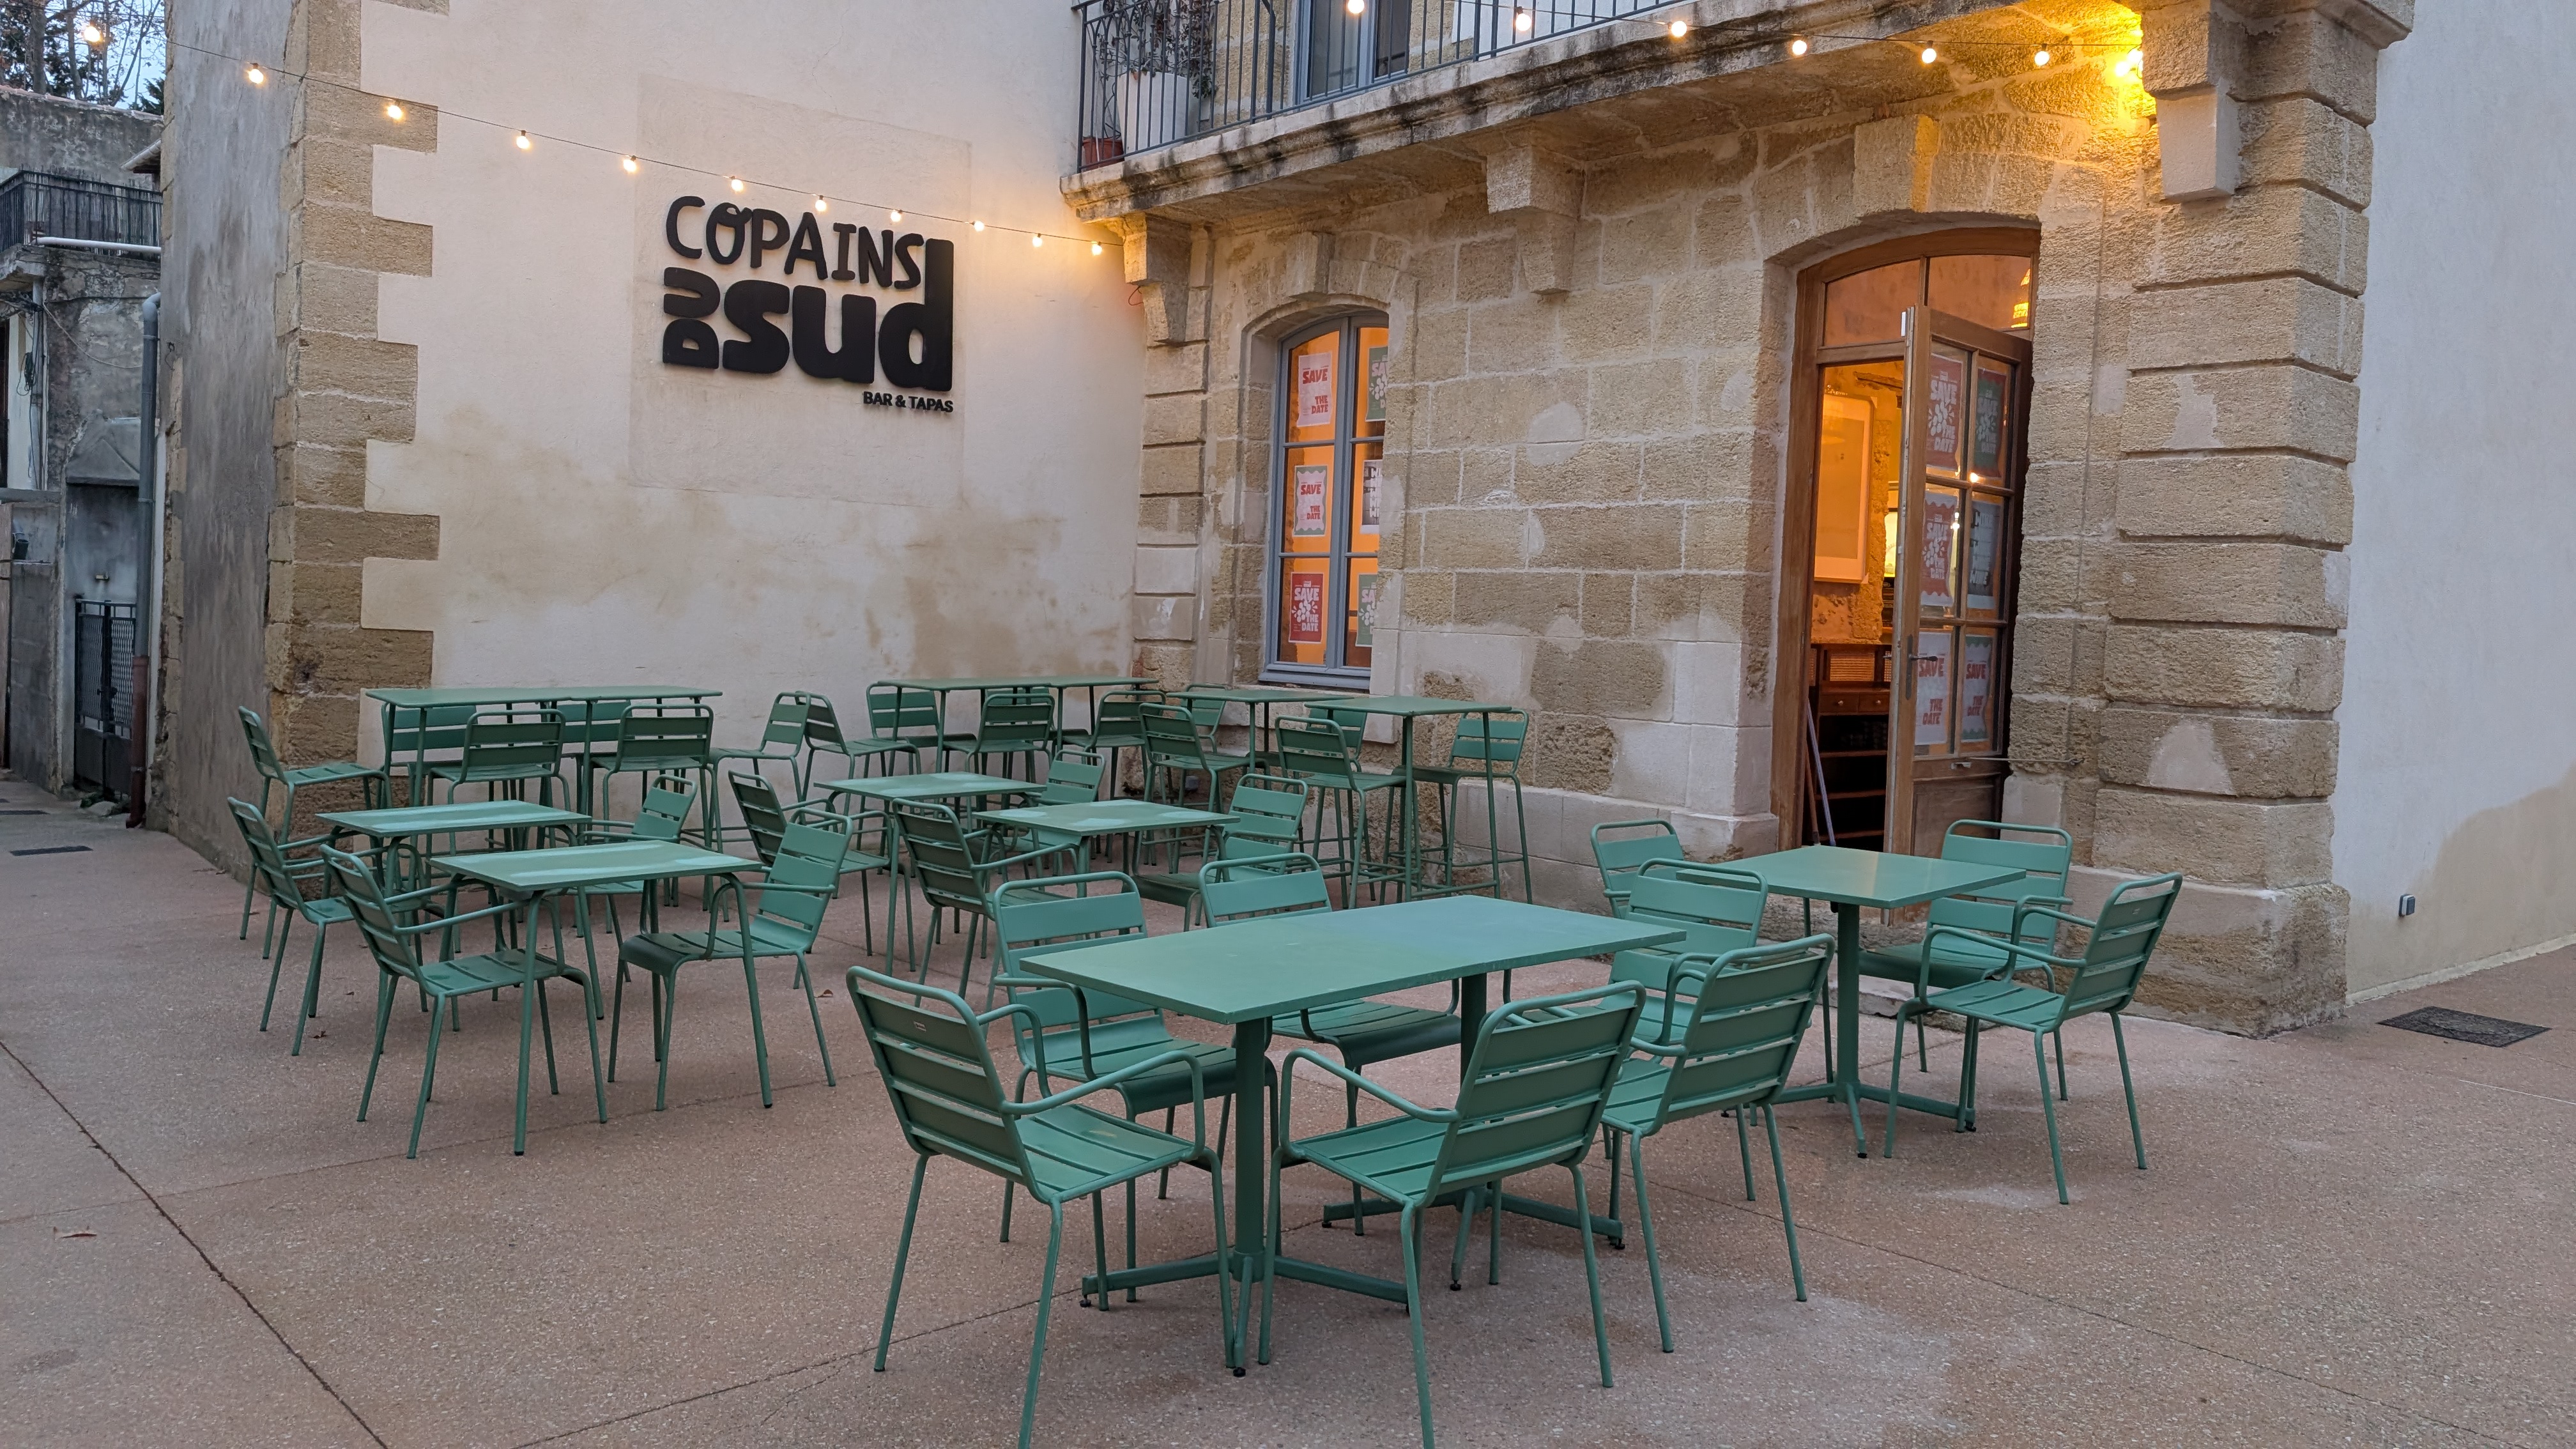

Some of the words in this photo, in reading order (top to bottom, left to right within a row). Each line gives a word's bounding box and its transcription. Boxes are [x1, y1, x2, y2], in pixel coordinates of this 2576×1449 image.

[666, 196, 924, 289] COPAINS
[1303, 369, 1328, 384] SAVE
[1315, 395, 1328, 404] THE
[1930, 380, 1958, 406] SAVE
[863, 391, 893, 406] BAR
[895, 395, 907, 408] &
[908, 396, 953, 413] TAPAS
[1312, 404, 1329, 414] DATE
[1934, 437, 1954, 452] DATE
[1300, 484, 1322, 495] SAVE
[1927, 523, 1948, 541] SAVE
[1294, 588, 1319, 601] SAVE
[1361, 589, 1376, 603] SA
[1307, 614, 1319, 623] THE
[1301, 623, 1319, 631] DATE
[1919, 657, 1944, 677] SAVE
[1966, 664, 1986, 678] SAVE
[1930, 699, 1943, 711] THE
[1922, 712, 1941, 724] DATE
